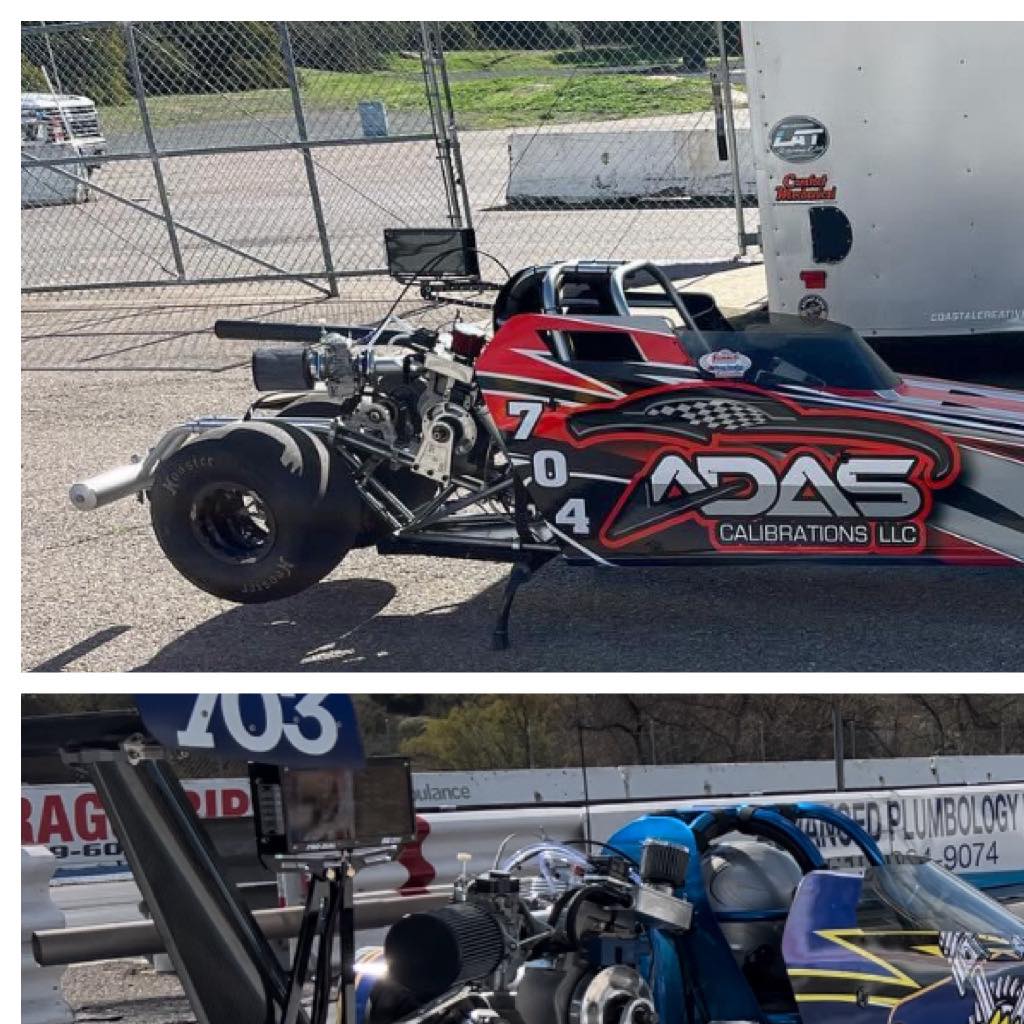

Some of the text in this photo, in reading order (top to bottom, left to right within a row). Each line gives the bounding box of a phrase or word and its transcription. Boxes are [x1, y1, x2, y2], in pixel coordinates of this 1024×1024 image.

[650, 454, 921, 518] ADAS
[718, 524, 917, 544] CALIBRATIONS LLC
[413, 783, 472, 801] ulance
[886, 793, 1019, 842] PLUMBOLOGY
